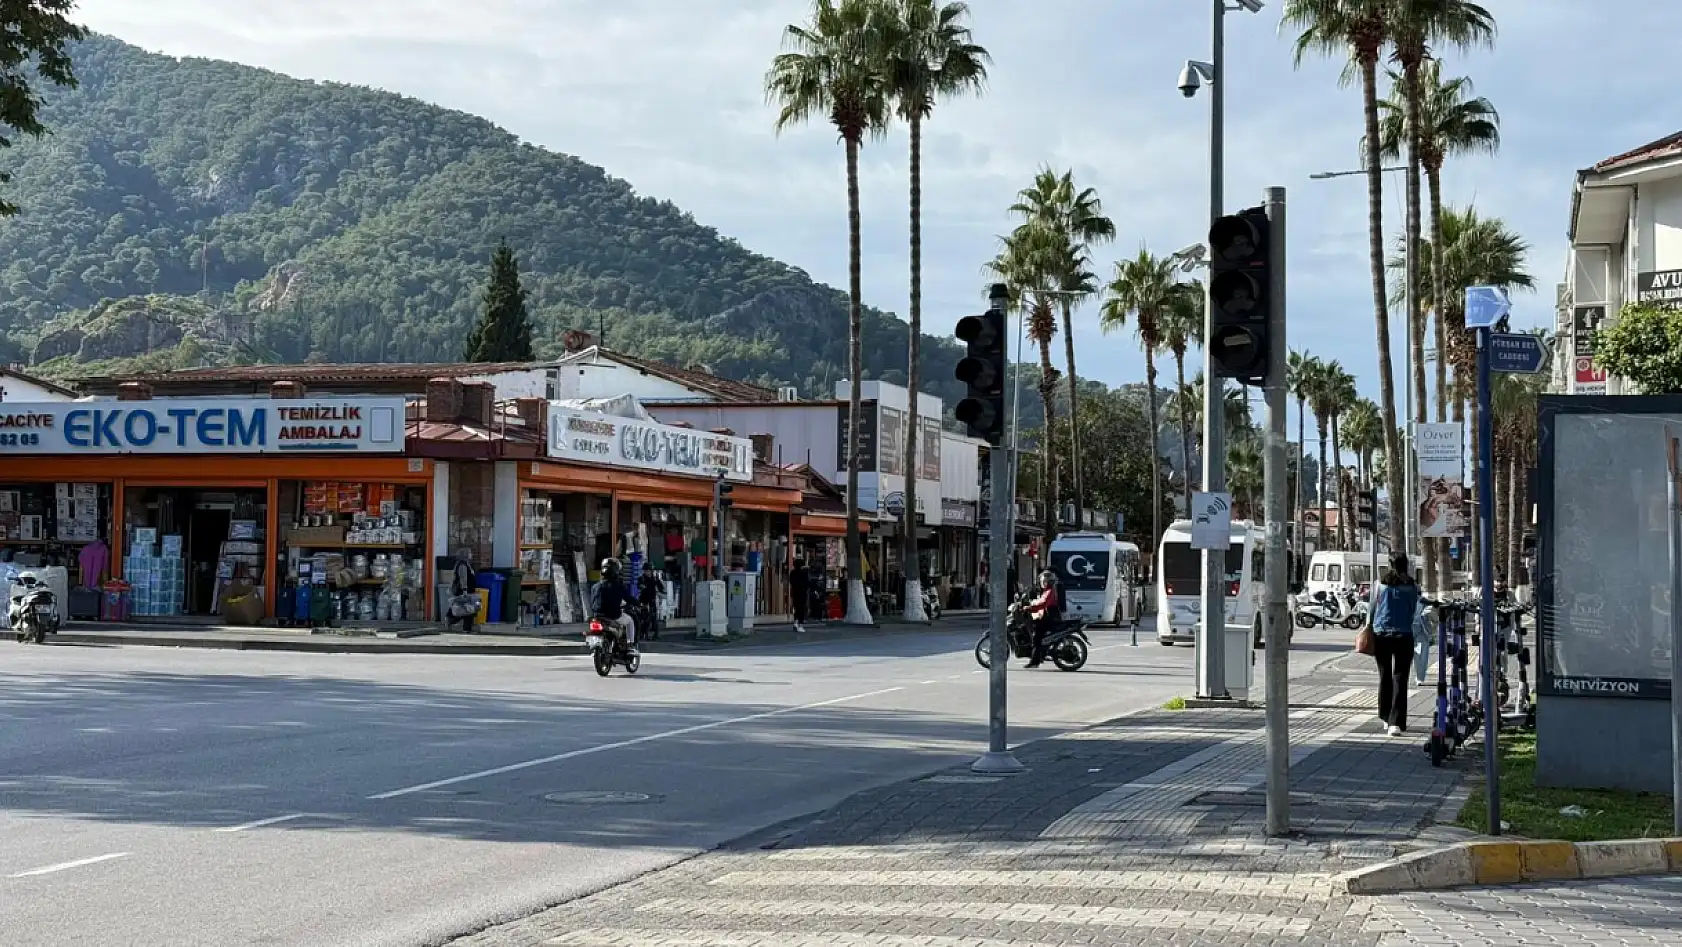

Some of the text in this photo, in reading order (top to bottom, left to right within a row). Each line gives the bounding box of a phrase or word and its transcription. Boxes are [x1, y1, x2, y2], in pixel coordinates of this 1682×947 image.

[277, 403, 362, 420] TEMİZLİK
[63, 409, 266, 447] EKO-TEM
[278, 425, 361, 440] AMBALAJ
[1553, 678, 1639, 692] KENTVİZYON
